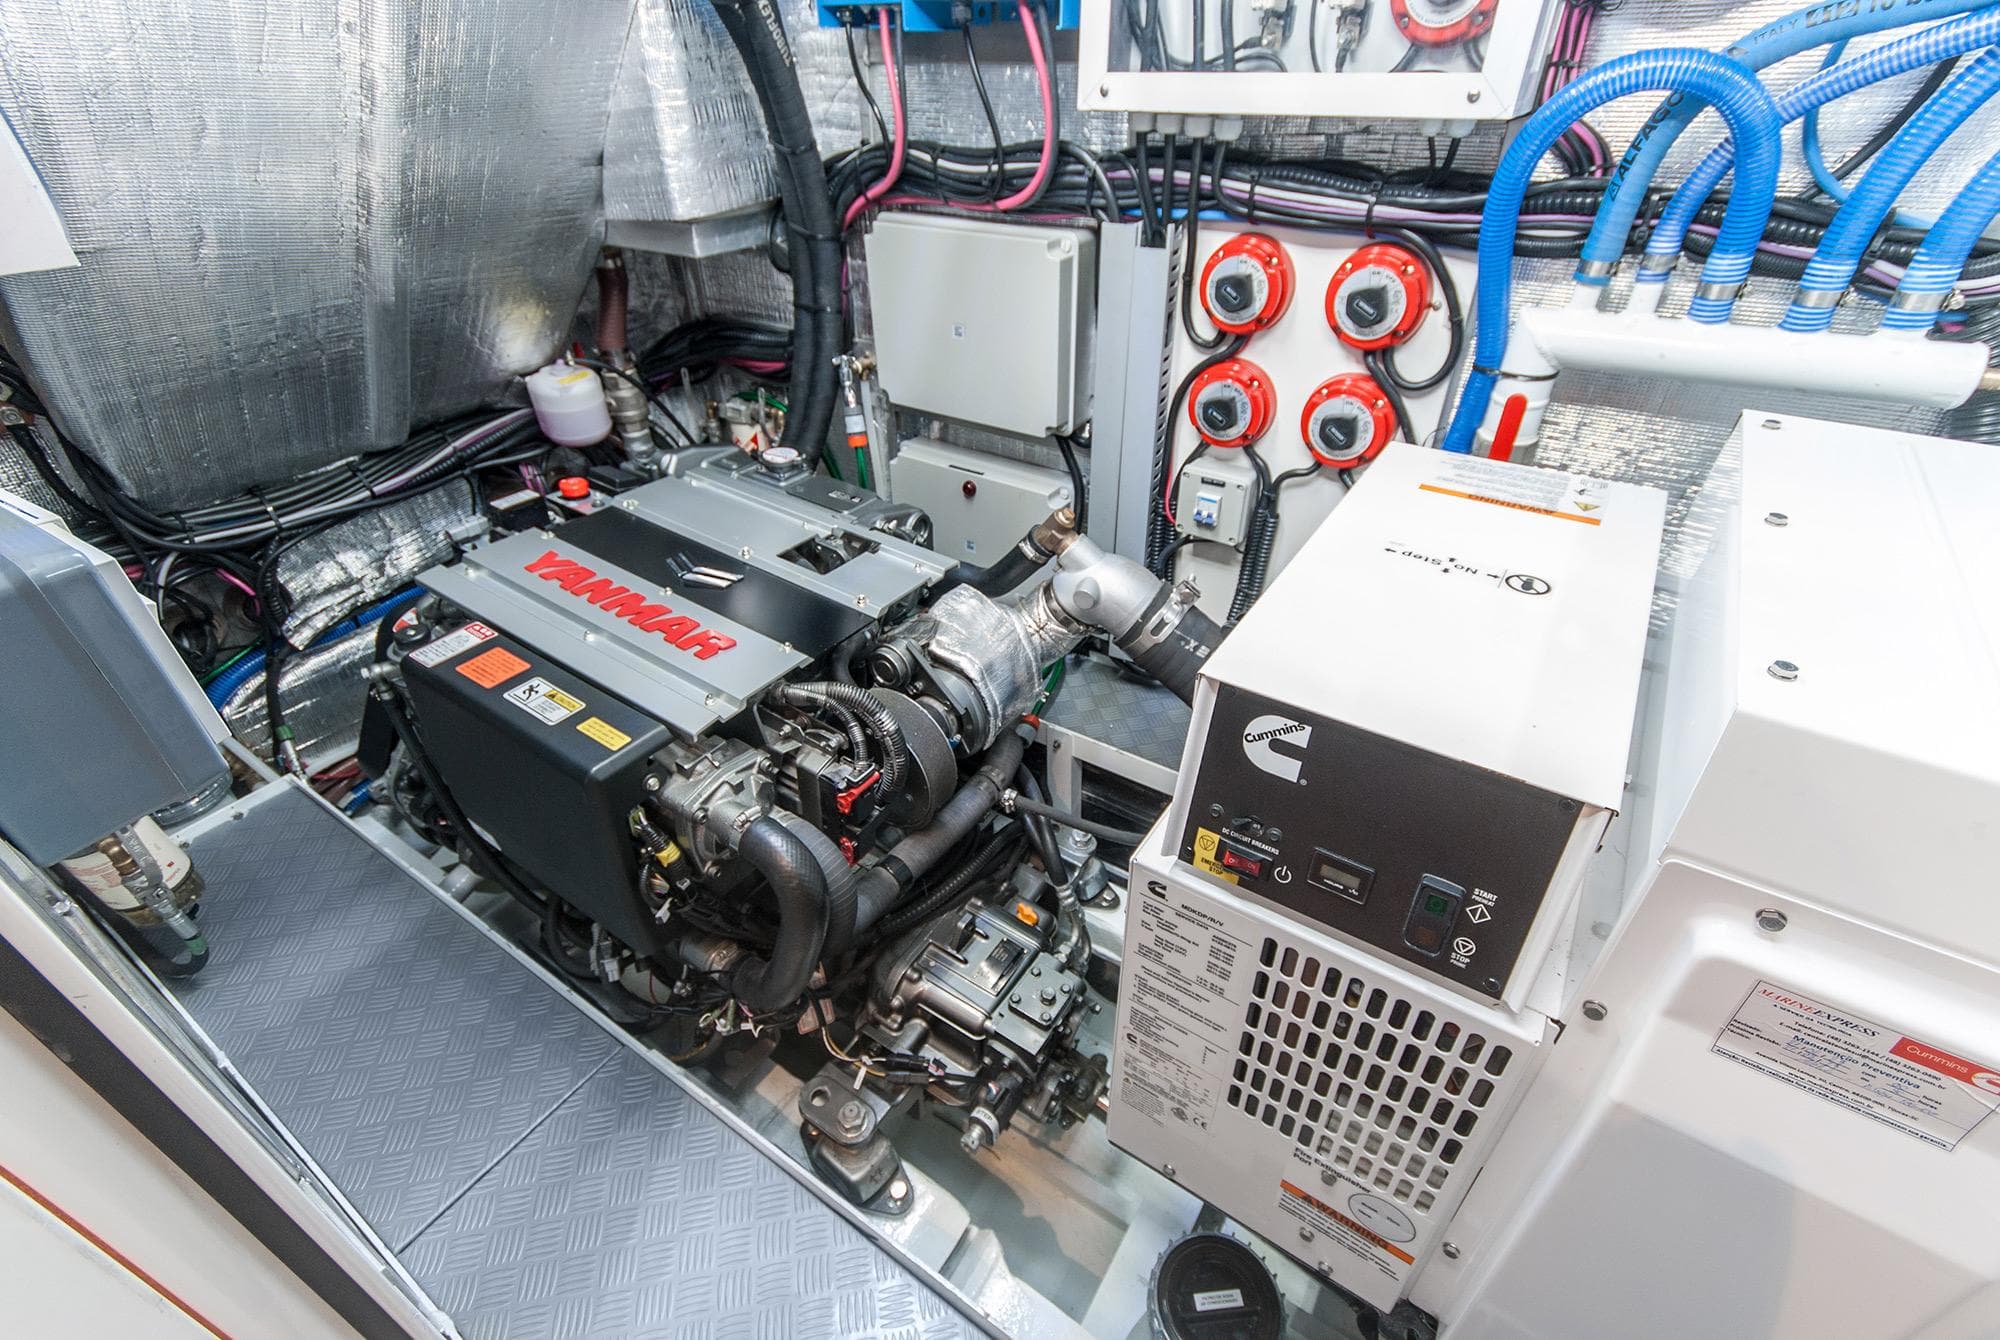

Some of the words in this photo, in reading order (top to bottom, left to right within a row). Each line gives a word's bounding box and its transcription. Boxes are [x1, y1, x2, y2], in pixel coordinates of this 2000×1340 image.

[1753, 18, 1799, 45] ITALY
[1401, 551, 1442, 566] Step
[1454, 564, 1478, 575] No
[524, 549, 737, 661] YANMAR
[1244, 722, 1306, 743] Cummins
[1222, 827, 1230, 835] DC
[1230, 830, 1252, 844] CIRCUIT
[1251, 839, 1280, 856] BREAKERS
[1208, 866, 1224, 875] STOP
[1473, 887, 1498, 902] START
[1450, 951, 1471, 965] STOP
[1757, 987, 1880, 1038] MARINEEXPRESS
[1793, 1021, 1826, 1036] Telefone:
[1791, 1034, 1859, 1065] Manutenção
[1860, 1061, 1921, 1089] Preventiva
[1906, 1044, 1969, 1075] Cummins
[1292, 1152, 1312, 1166] Port
[1294, 1147, 1312, 1161] Fire
[1314, 1155, 1371, 1194] Extinguisher
[1312, 1197, 1389, 1250] WARNING
